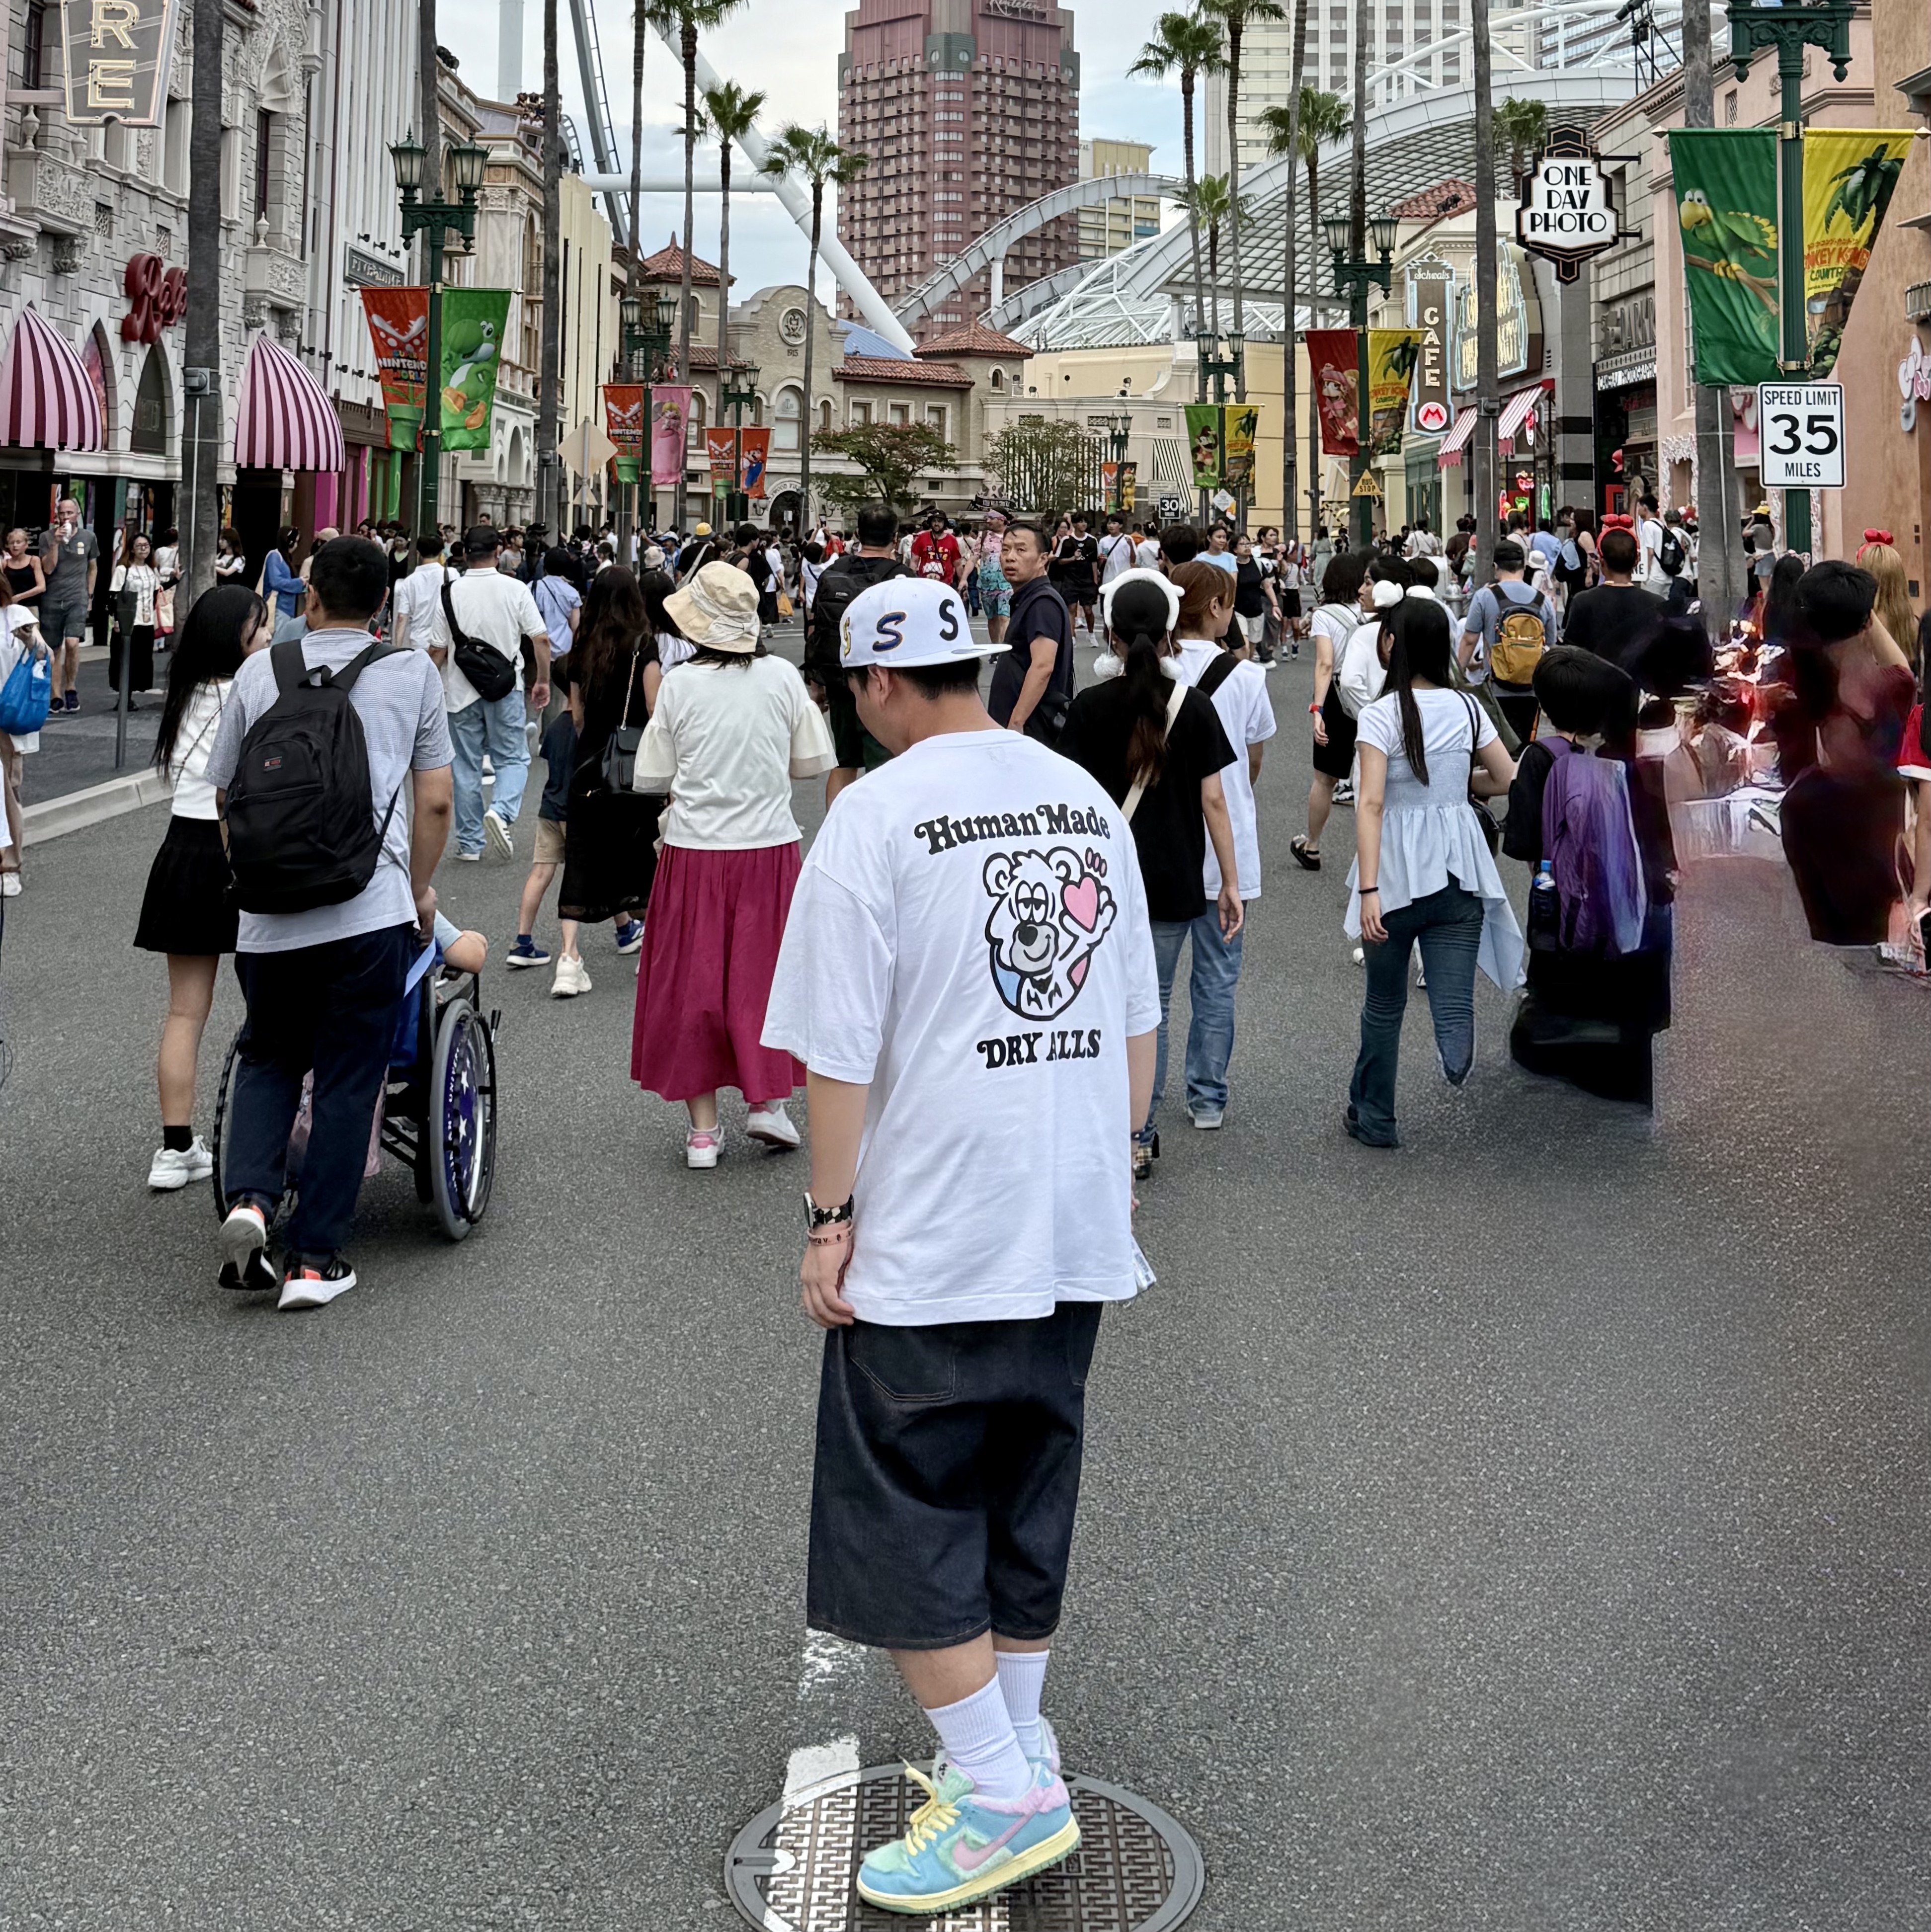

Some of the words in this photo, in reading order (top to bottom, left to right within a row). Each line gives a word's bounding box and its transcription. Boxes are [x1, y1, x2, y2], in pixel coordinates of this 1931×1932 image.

[1544, 166, 1592, 186] ONE
[1547, 190, 1590, 210] DAY
[1530, 213, 1607, 232] PHOTO
[1810, 267, 1843, 281] COUNTR
[1423, 307, 1441, 387] CAFE
[1765, 390, 1801, 405] SPEED
[1806, 391, 1838, 406] LIMIT
[1769, 413, 1838, 455] 35
[1785, 463, 1821, 477] MILES
[1161, 499, 1179, 511] 30
[873, 611, 907, 652] S
[939, 598, 959, 641] S
[914, 813, 1042, 855] Human
[1036, 803, 1111, 840] Made
[977, 1032, 1043, 1069] DRY
[1046, 1029, 1101, 1060] ALLS
